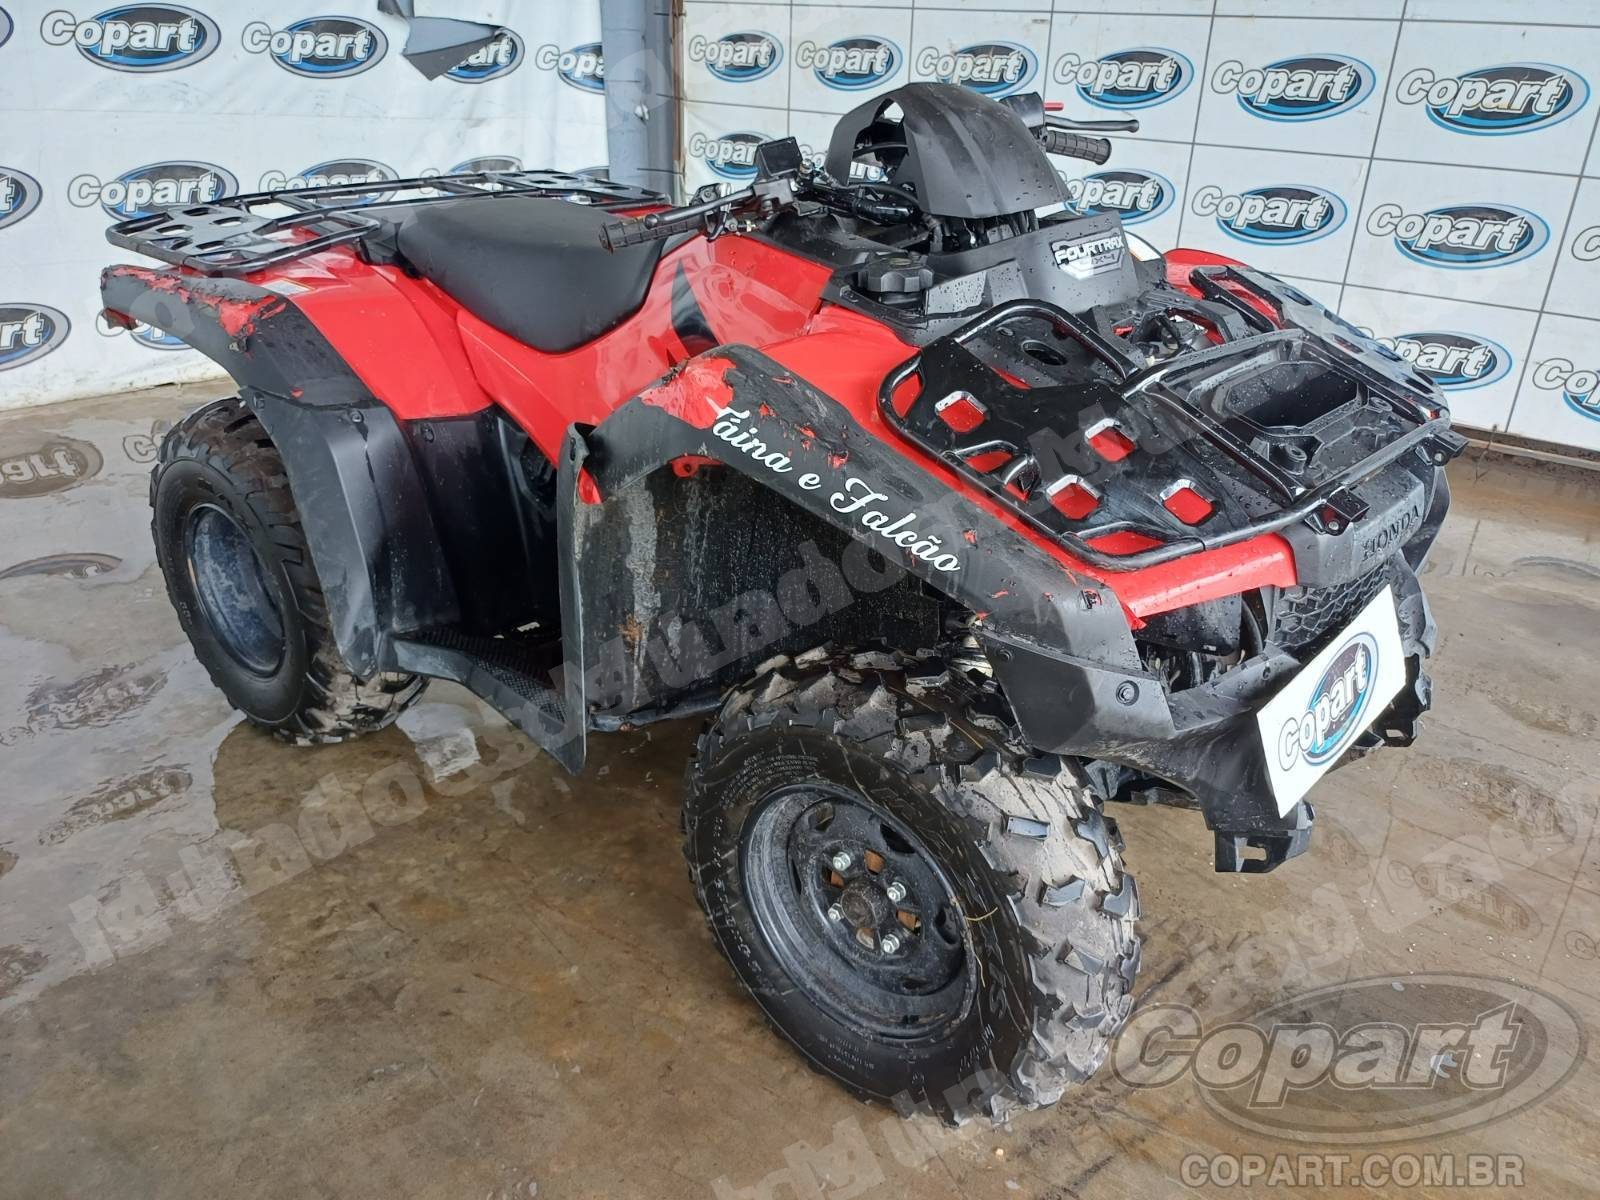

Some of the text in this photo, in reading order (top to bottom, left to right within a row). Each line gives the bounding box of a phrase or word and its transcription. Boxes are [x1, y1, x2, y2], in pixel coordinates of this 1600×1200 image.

[40, 10, 198, 59] Copart
[242, 22, 371, 66] Copart
[689, 35, 771, 72] Copart
[797, 41, 889, 79] Copart
[916, 46, 1023, 84] Copart
[1054, 53, 1178, 96] Copart
[1211, 60, 1356, 105] Copart
[1398, 68, 1571, 118] Copart
[689, 132, 759, 167] Copar
[67, 172, 217, 213] Copart
[1060, 174, 1160, 211] opart
[1192, 185, 1329, 229] Copart
[1054, 236, 1125, 264] FOURTRAX
[1367, 203, 1528, 253] Copart
[798, 473, 822, 490] e
[829, 477, 961, 572] Falcão
[1362, 504, 1420, 562] HONDA
[1278, 641, 1368, 772] Copart
